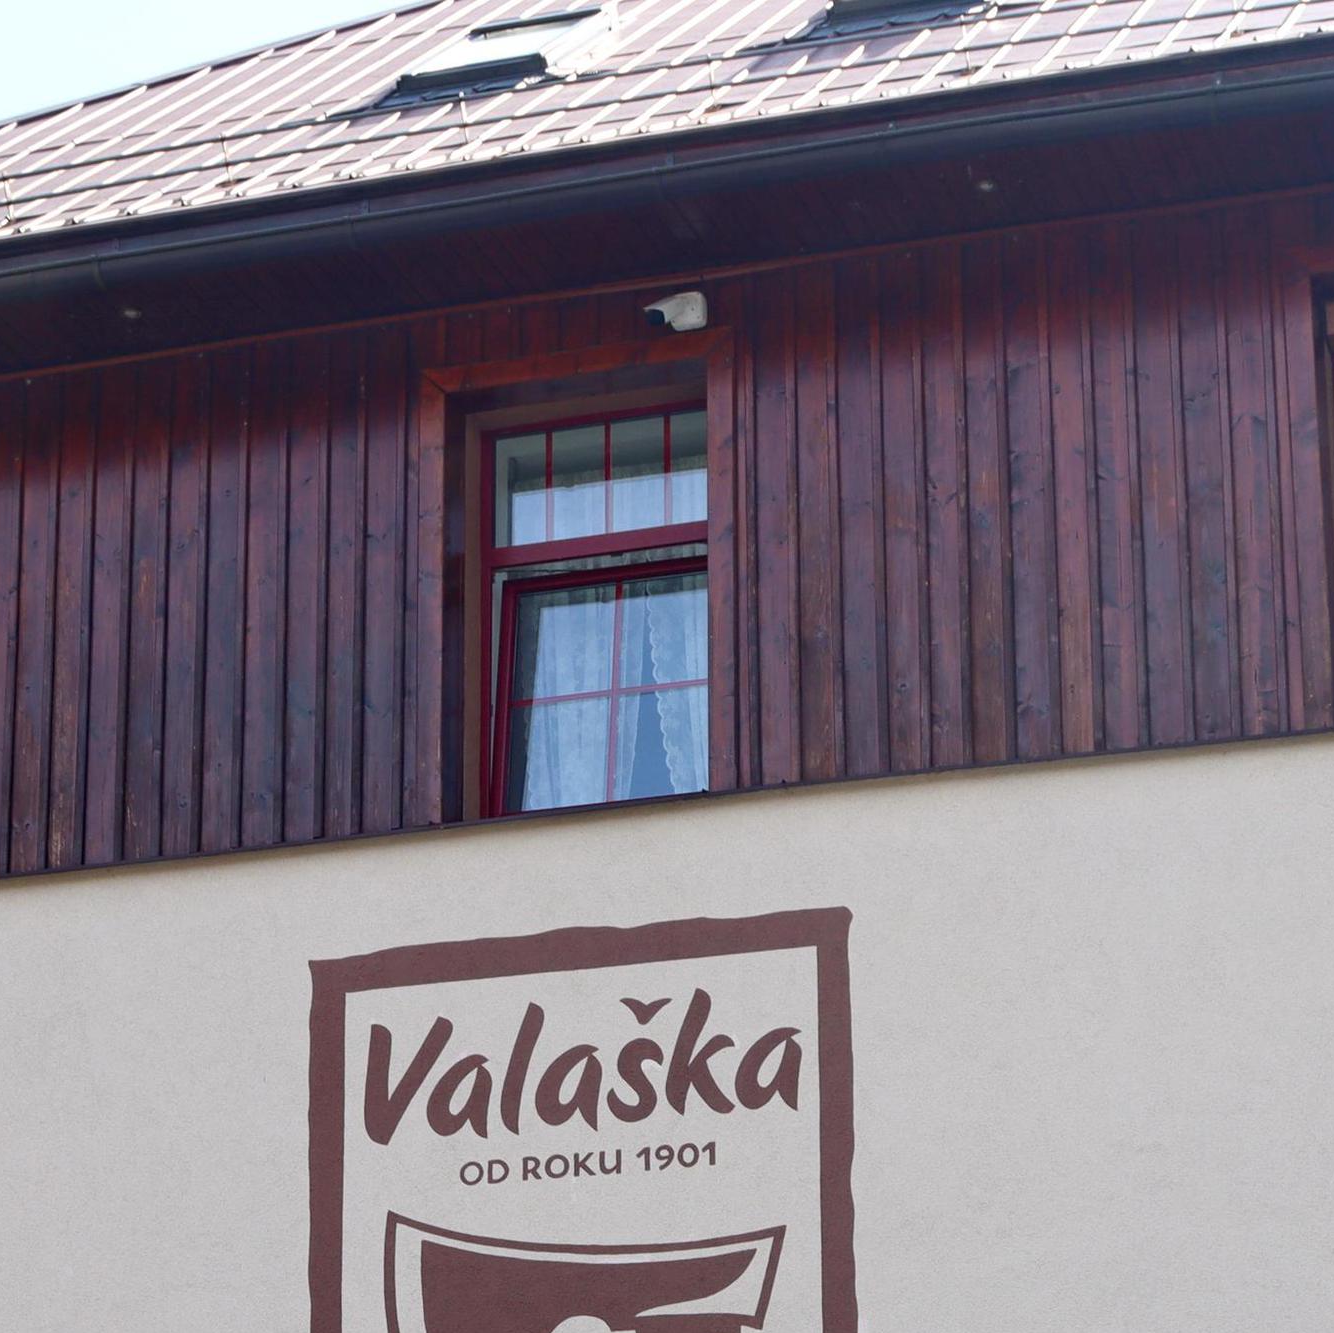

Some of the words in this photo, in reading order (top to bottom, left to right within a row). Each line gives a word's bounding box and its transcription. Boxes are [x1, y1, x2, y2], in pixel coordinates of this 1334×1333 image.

[364, 988, 802, 1145] Valaška
[460, 1159, 509, 1186] OD
[522, 1149, 622, 1181] ROKU
[636, 1141, 716, 1171] 1901
